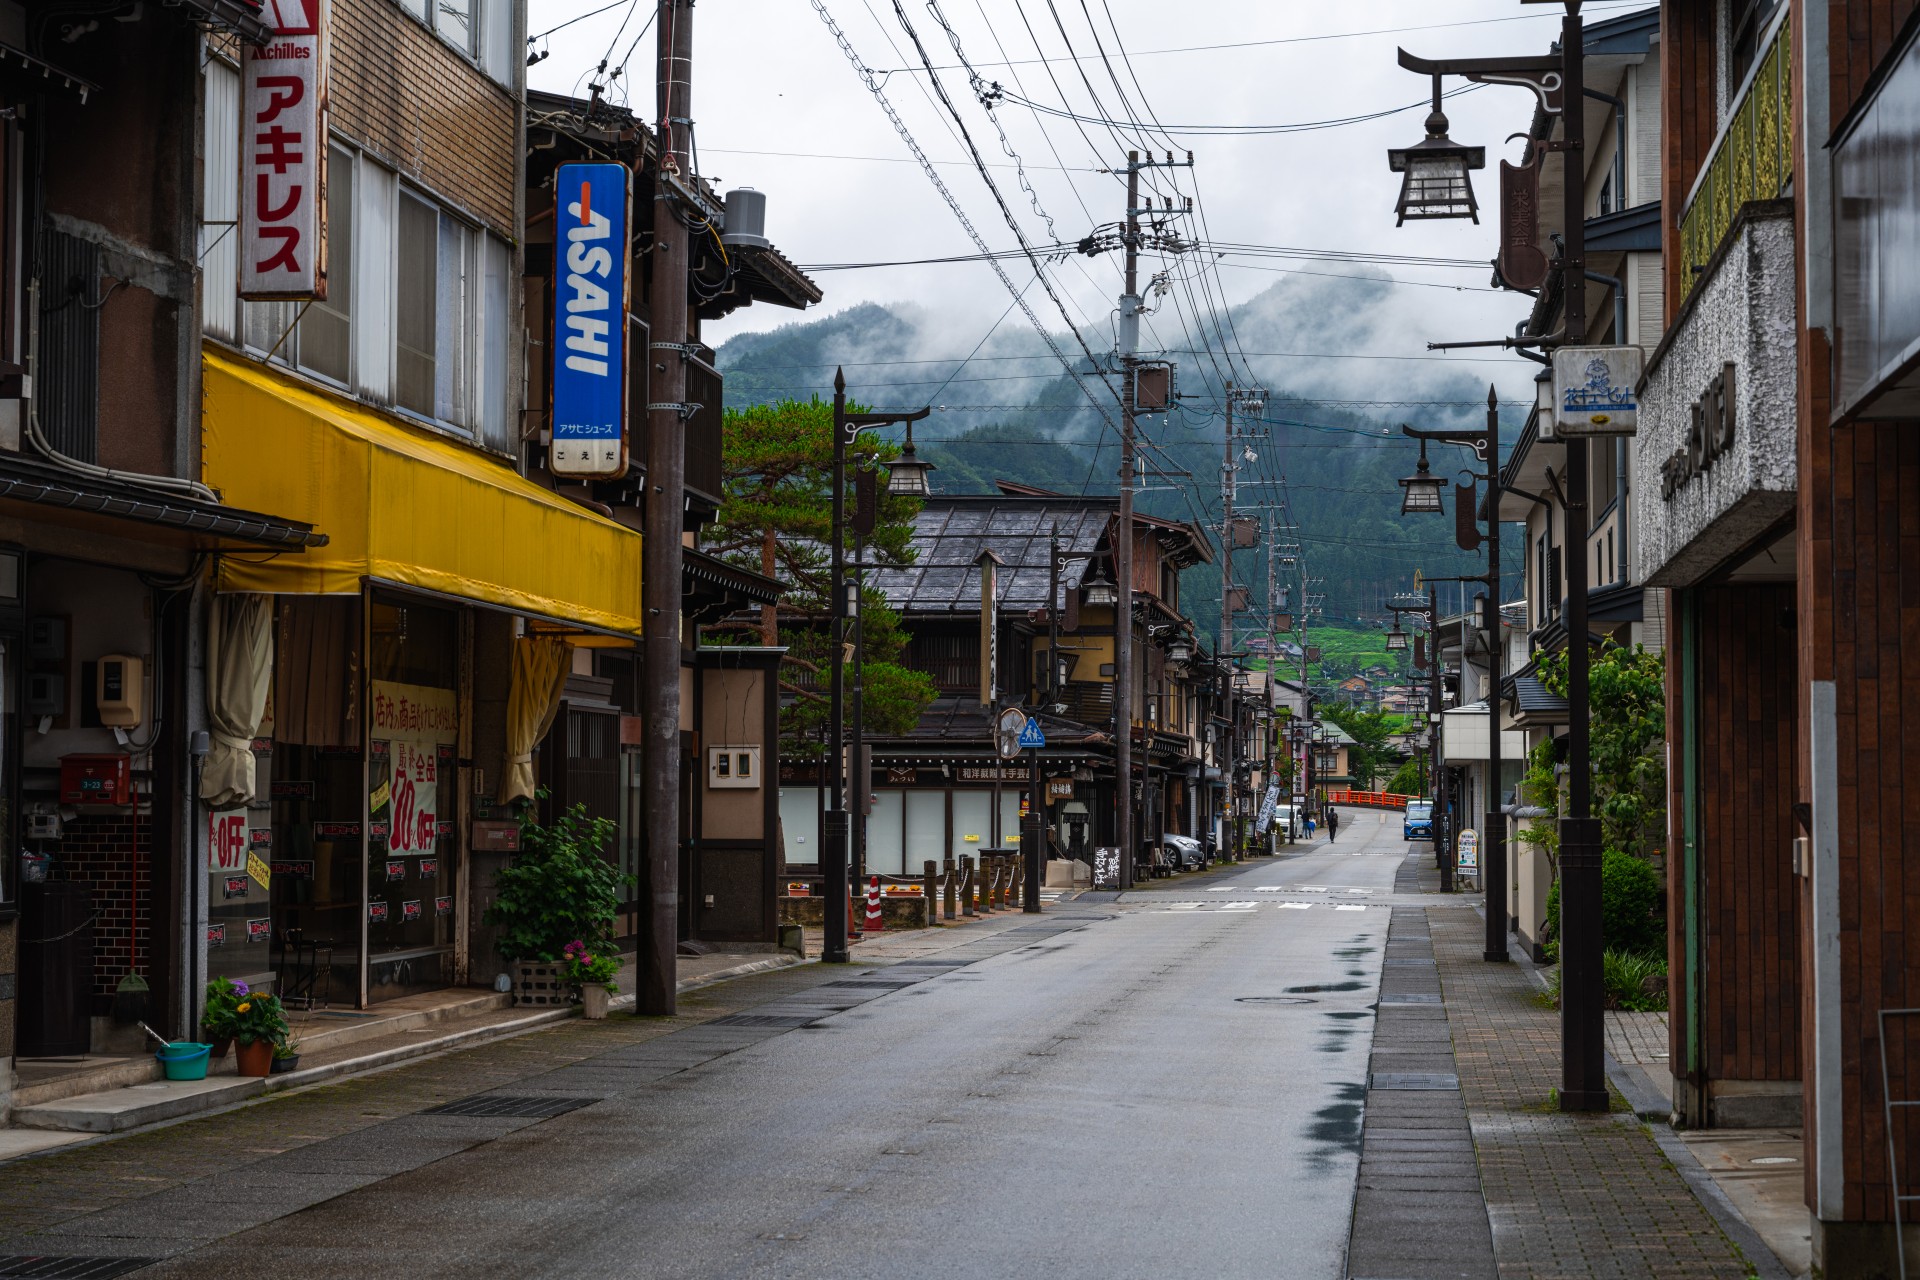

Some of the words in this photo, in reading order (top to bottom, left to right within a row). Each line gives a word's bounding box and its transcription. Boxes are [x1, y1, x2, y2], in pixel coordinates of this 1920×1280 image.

[251, 43, 310, 60] Achilles
[256, 76, 304, 273] アキレス
[565, 181, 613, 377] ASAHI
[559, 424, 613, 434] アサヒシューズ
[557, 451, 614, 460] こえだ
[218, 816, 245, 868] OFF
[417, 809, 435, 850] OFF
